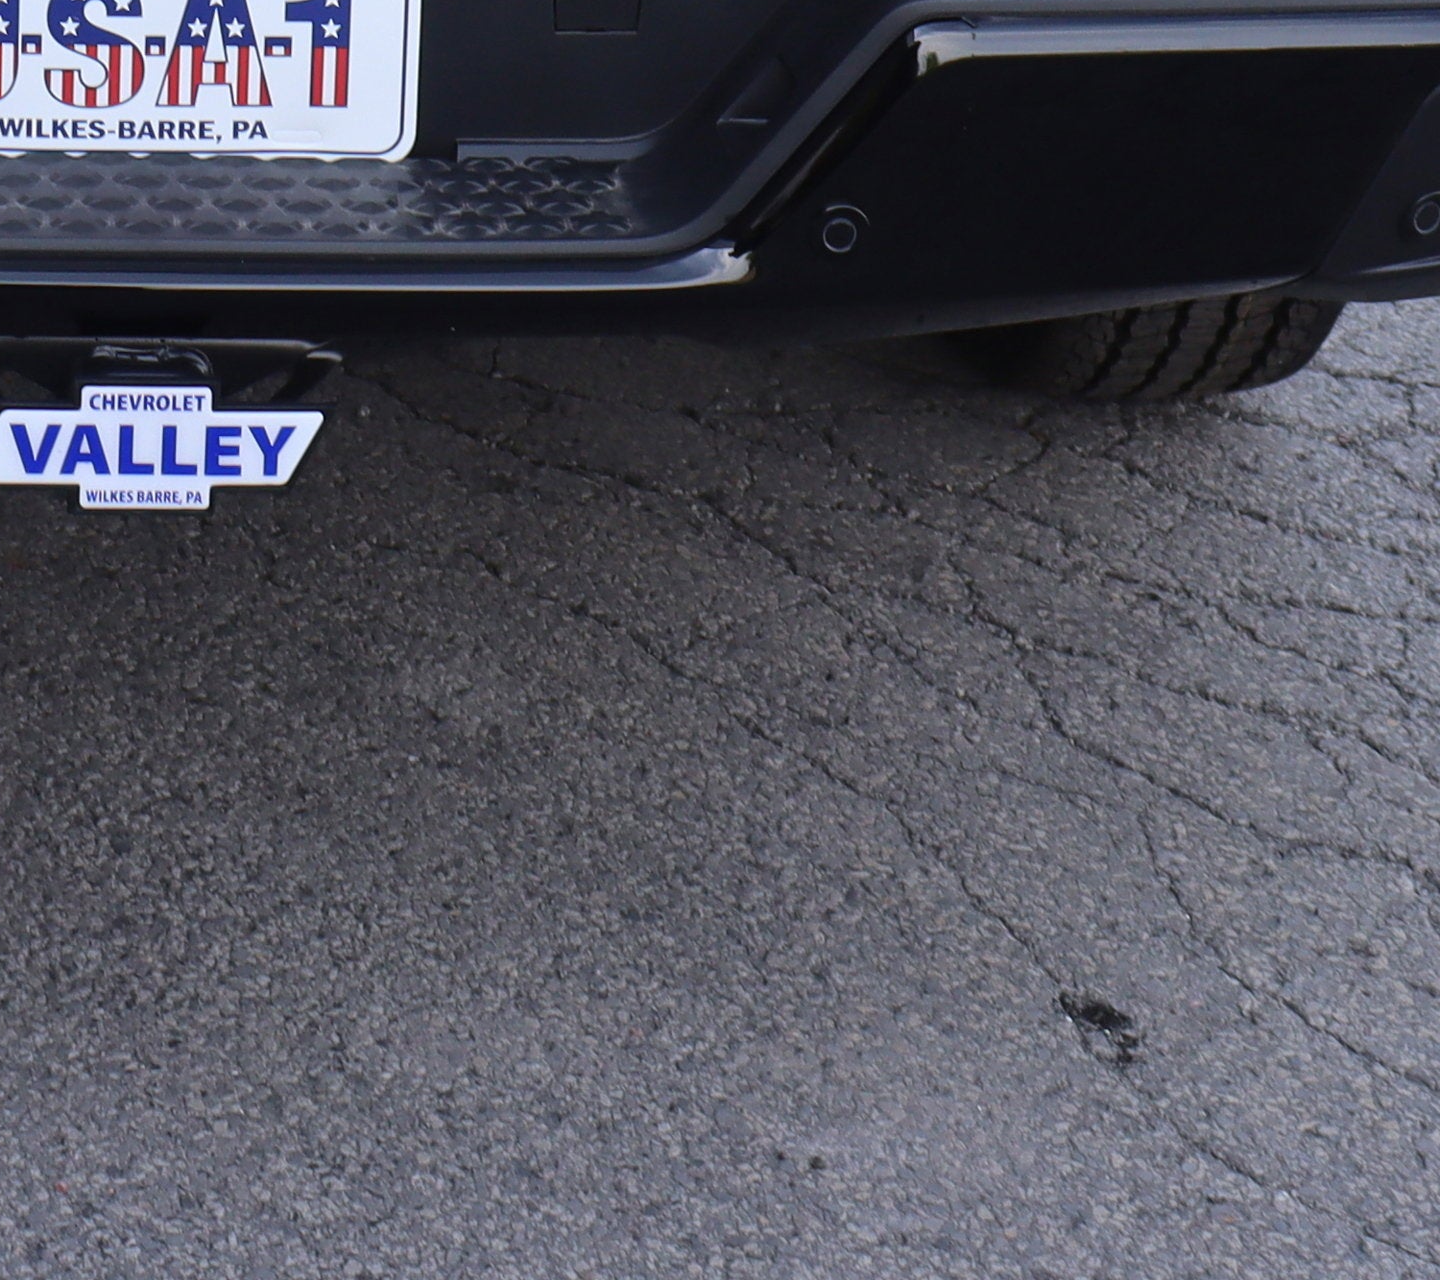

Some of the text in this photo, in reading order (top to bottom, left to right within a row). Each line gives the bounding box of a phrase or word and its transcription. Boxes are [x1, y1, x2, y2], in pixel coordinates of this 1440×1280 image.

[232, 119, 268, 141] PA
[88, 393, 206, 413] CHEVROLET
[9, 423, 298, 477] VALLEY
[85, 489, 203, 506] WILKES BARRE, PA
